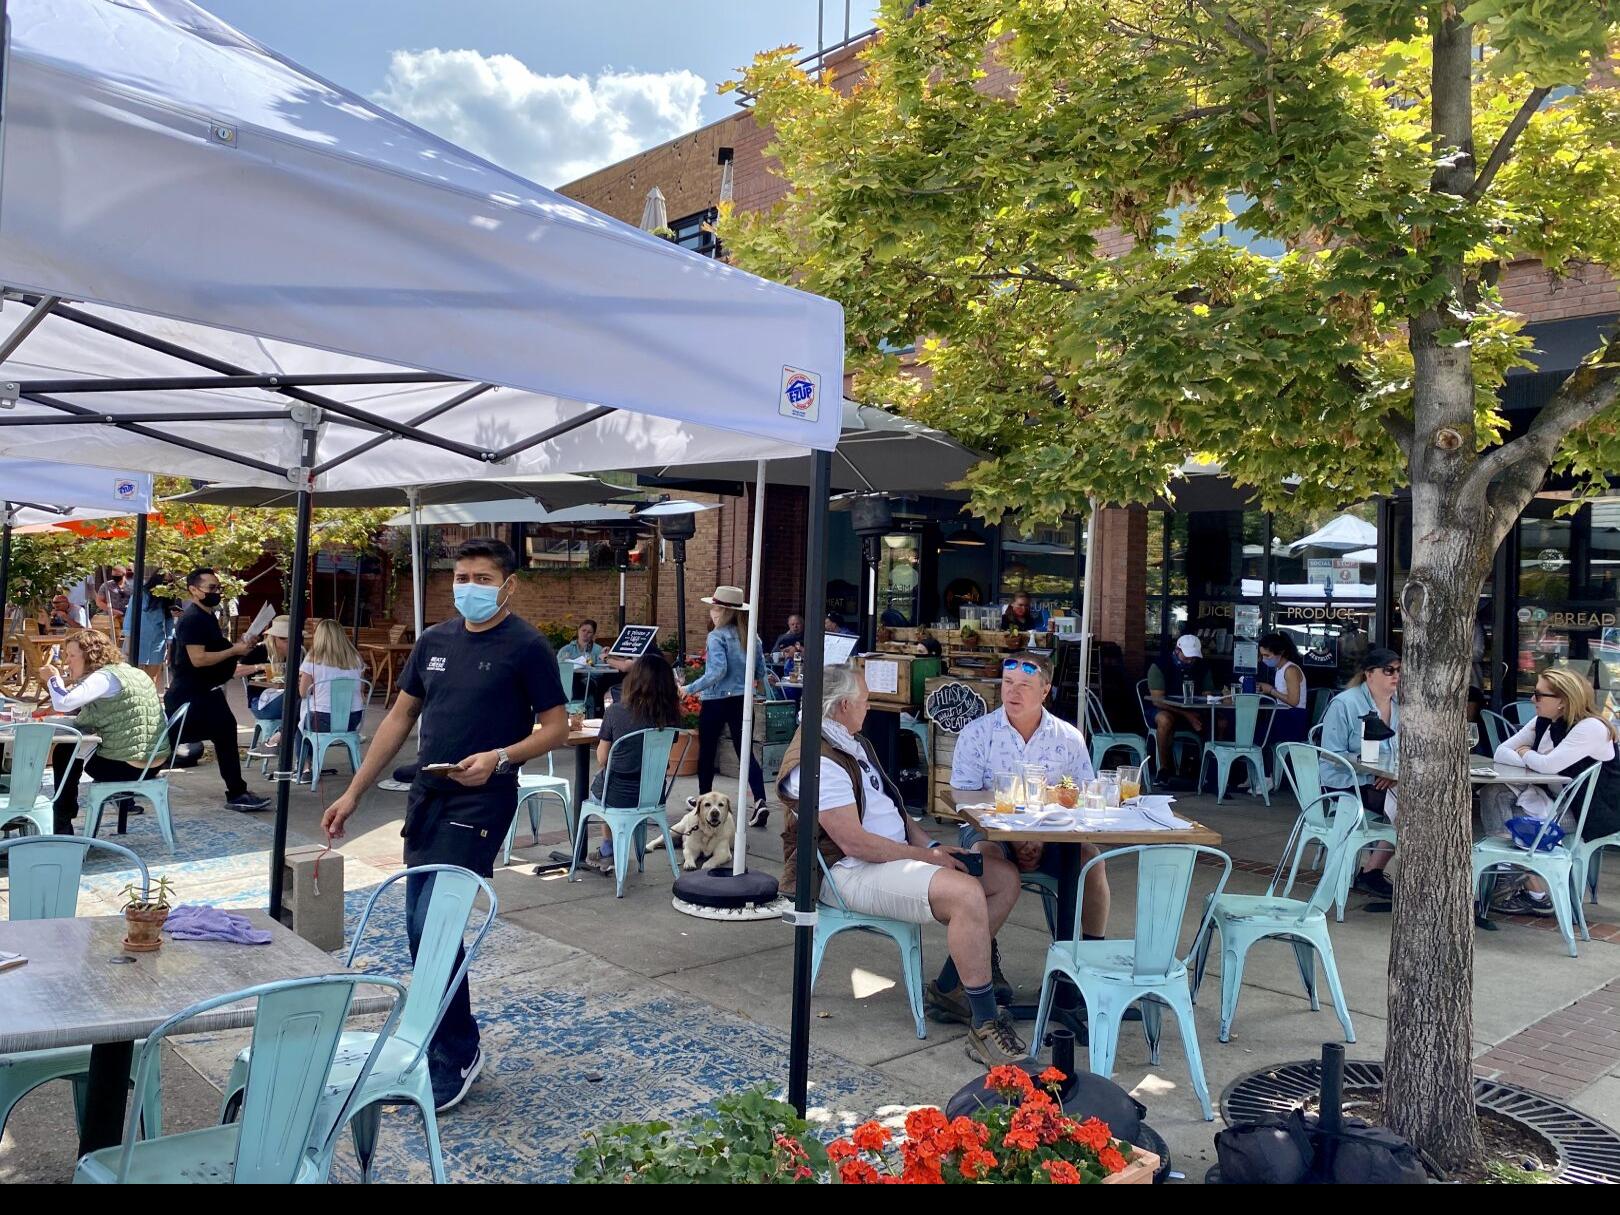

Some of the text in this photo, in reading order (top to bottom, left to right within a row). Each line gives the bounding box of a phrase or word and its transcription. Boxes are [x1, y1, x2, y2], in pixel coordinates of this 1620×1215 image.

[1287, 607, 1355, 620] PRODUCE
[1554, 612, 1616, 627] BREAD
[936, 686, 961, 705] PLEASE
